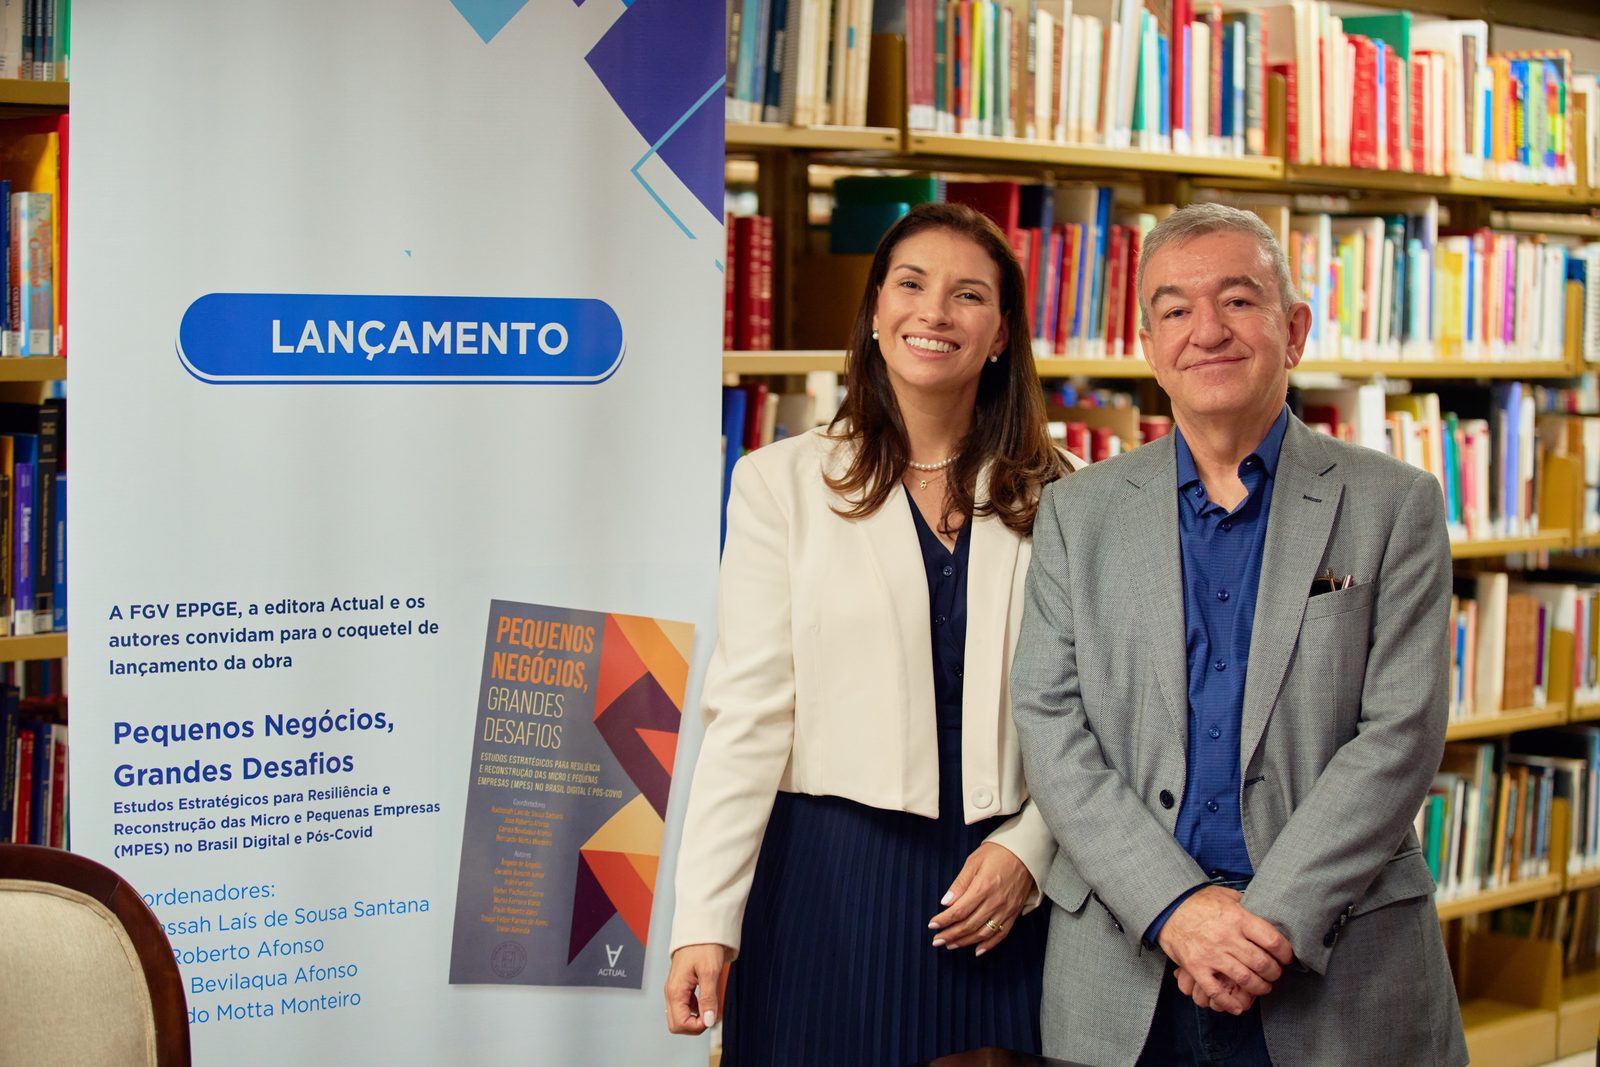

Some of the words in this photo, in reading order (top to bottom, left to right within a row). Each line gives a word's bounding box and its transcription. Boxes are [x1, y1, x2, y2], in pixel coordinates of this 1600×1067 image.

[272, 319, 568, 361] LANÇAMENTO
[109, 606, 123, 620] A
[131, 604, 169, 619] FGV
[177, 602, 242, 618] EPPGE,
[249, 604, 258, 615] a
[265, 599, 324, 614] editora
[331, 595, 383, 611] Actual
[390, 598, 399, 609] e
[406, 598, 425, 608] os
[109, 633, 179, 647] autores
[186, 628, 273, 644] convidam
[281, 628, 316, 643] para
[322, 628, 332, 638] o
[338, 621, 411, 639] coquetel
[418, 620, 438, 634] de
[496, 615, 595, 654] PEQUENOS
[110, 658, 217, 676] lançamento
[224, 655, 245, 670] da
[252, 654, 292, 668] obra
[491, 651, 589, 694] NEGÓCIOS,
[487, 686, 564, 718] GRANDES
[115, 721, 254, 747] Pequenos
[265, 708, 393, 738] Negócios,
[483, 717, 562, 749] DESAFIOS
[114, 760, 232, 787] Grandes
[243, 752, 353, 779] Desafios
[479, 764, 483, 773] E
[484, 764, 533, 779] RECONSTRUÇÃO
[535, 770, 546, 779] DAS
[548, 771, 566, 781] MICRO
[567, 773, 571, 781] E
[480, 752, 507, 762] ESTUDOS
[509, 754, 553, 768] ESTRATÉGICOS
[555, 760, 569, 769] PARA
[114, 800, 173, 813] Estudos
[179, 794, 268, 810] Estratégicos
[274, 793, 303, 806] para
[309, 785, 377, 801] Resiliência
[383, 786, 390, 795] e
[478, 777, 509, 788] EMPRESAS
[510, 780, 533, 791] (MPES)
[535, 783, 543, 791] NO
[545, 784, 565, 793] BRASIL
[114, 818, 216, 835] Reconstrução
[221, 816, 245, 828] das
[251, 814, 289, 826] Micro
[295, 814, 301, 823] e
[307, 808, 369, 822] Pequenas
[374, 803, 440, 817] Empresas
[114, 843, 169, 858] (MPES)
[175, 843, 192, 853] no
[198, 837, 237, 851] Brasil
[243, 834, 289, 849] Digital
[295, 836, 302, 844] e
[307, 826, 372, 843] Pós-Covid
[143, 883, 276, 907] ordenadores:
[219, 913, 256, 931] Laís
[264, 911, 288, 927] de
[295, 907, 347, 924] Sousa
[354, 900, 429, 917] Santana
[258, 939, 324, 957] Afonso
[192, 973, 287, 993] Bevilaqua
[295, 965, 357, 983] Afonso
[597, 968, 627, 978] ACTUAL
[218, 1002, 273, 1021] Motta
[282, 991, 360, 1014] Monteiro
